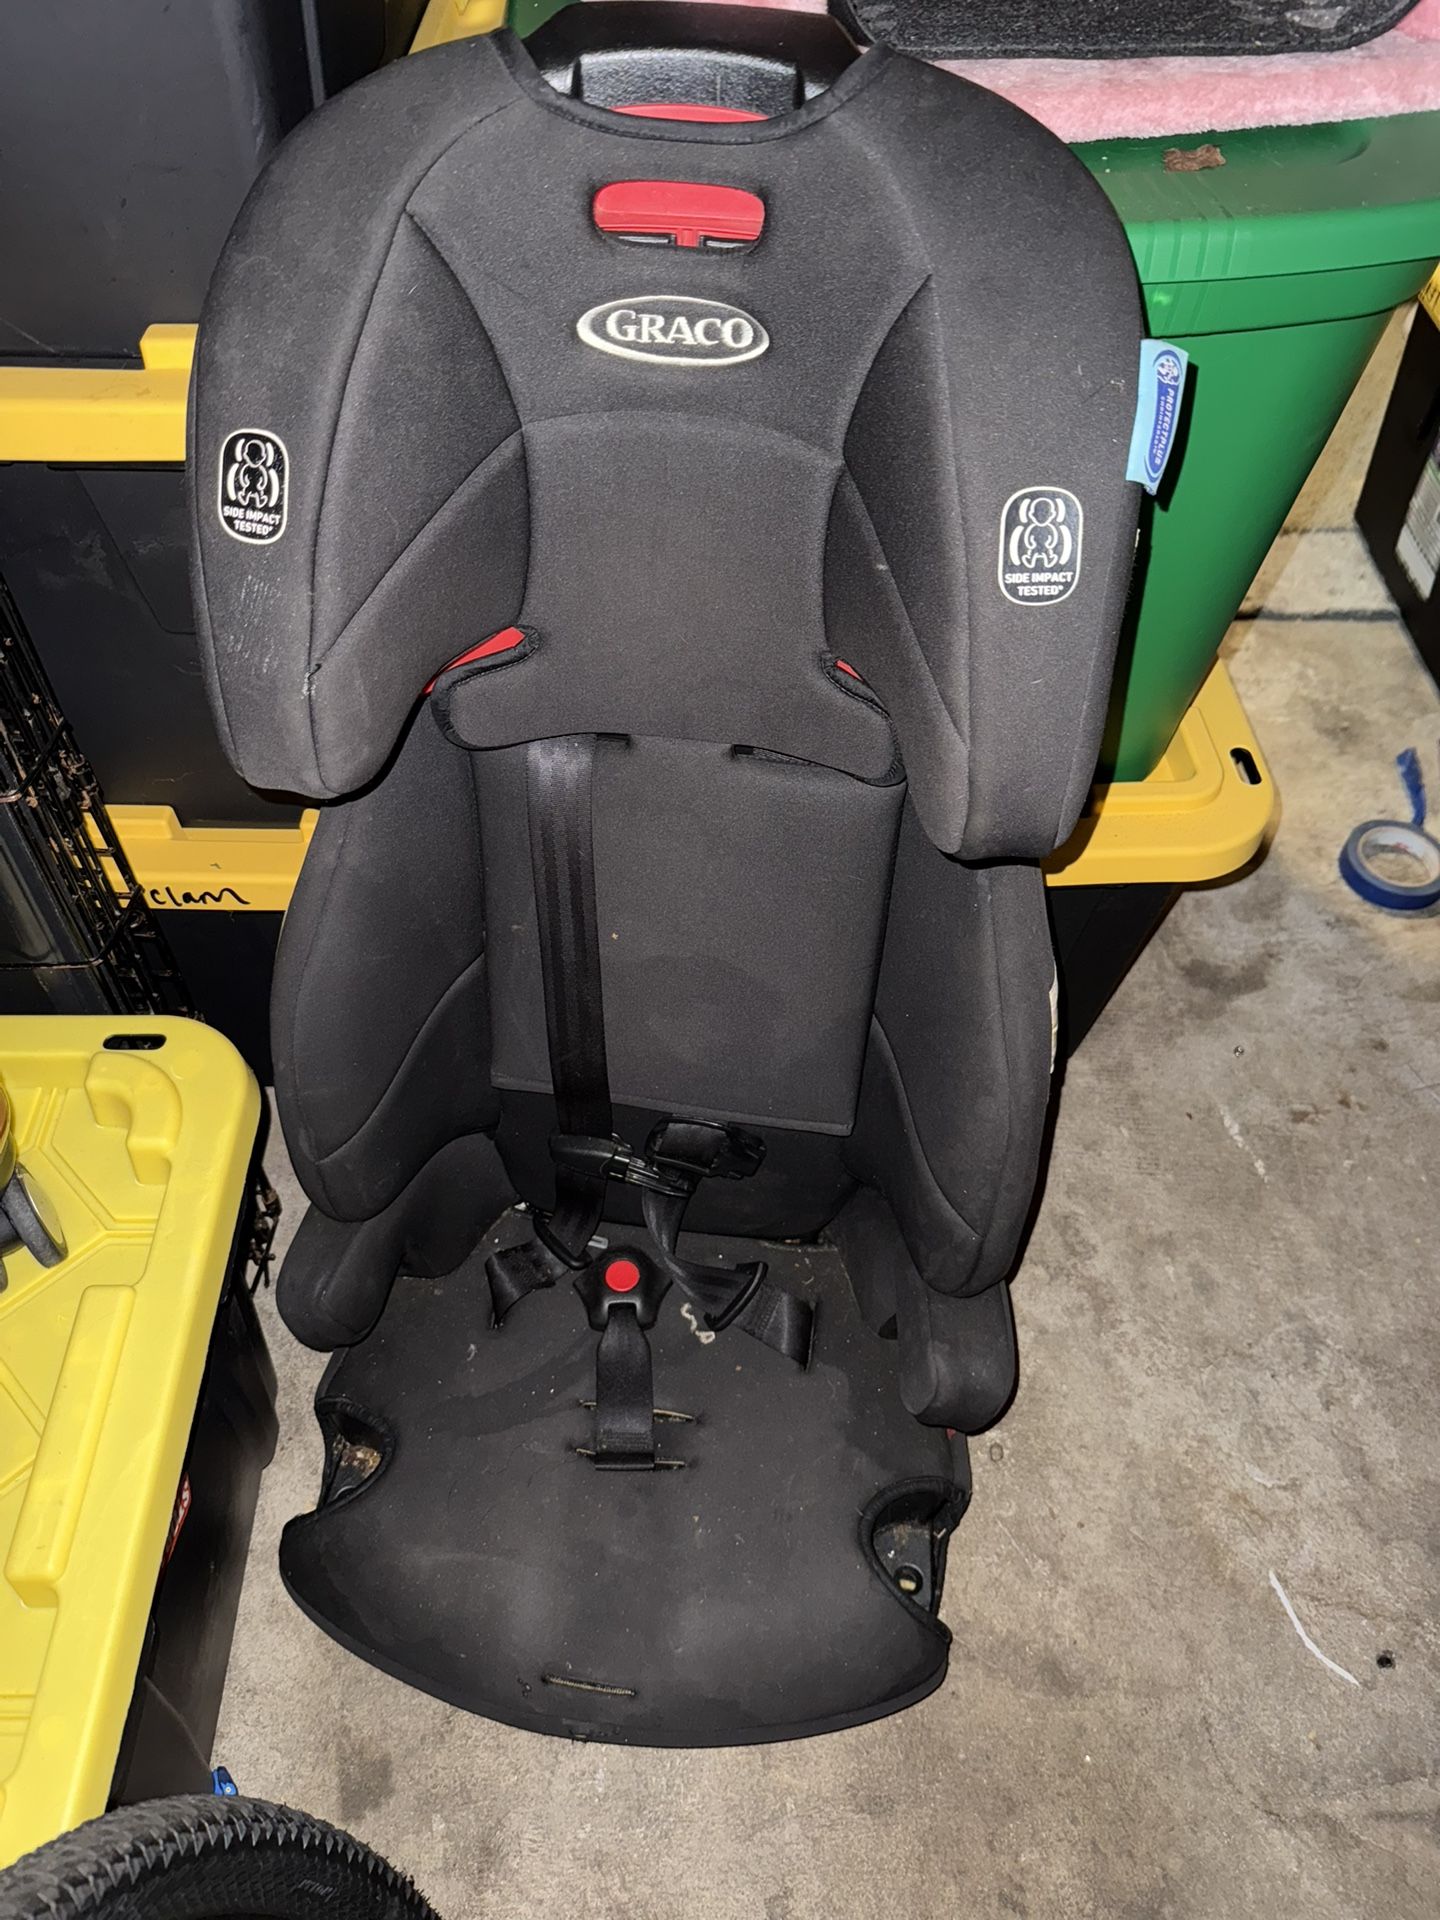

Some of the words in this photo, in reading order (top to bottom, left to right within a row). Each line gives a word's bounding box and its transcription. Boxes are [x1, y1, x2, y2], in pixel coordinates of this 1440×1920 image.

[606, 309, 754, 348] GRACO
[1154, 388, 1175, 466] PROTECTPLUS
[223, 505, 245, 520] SIDE
[246, 509, 281, 525] IMPACT
[1004, 572, 1030, 584] SIDE
[1031, 571, 1073, 583] IMPACT
